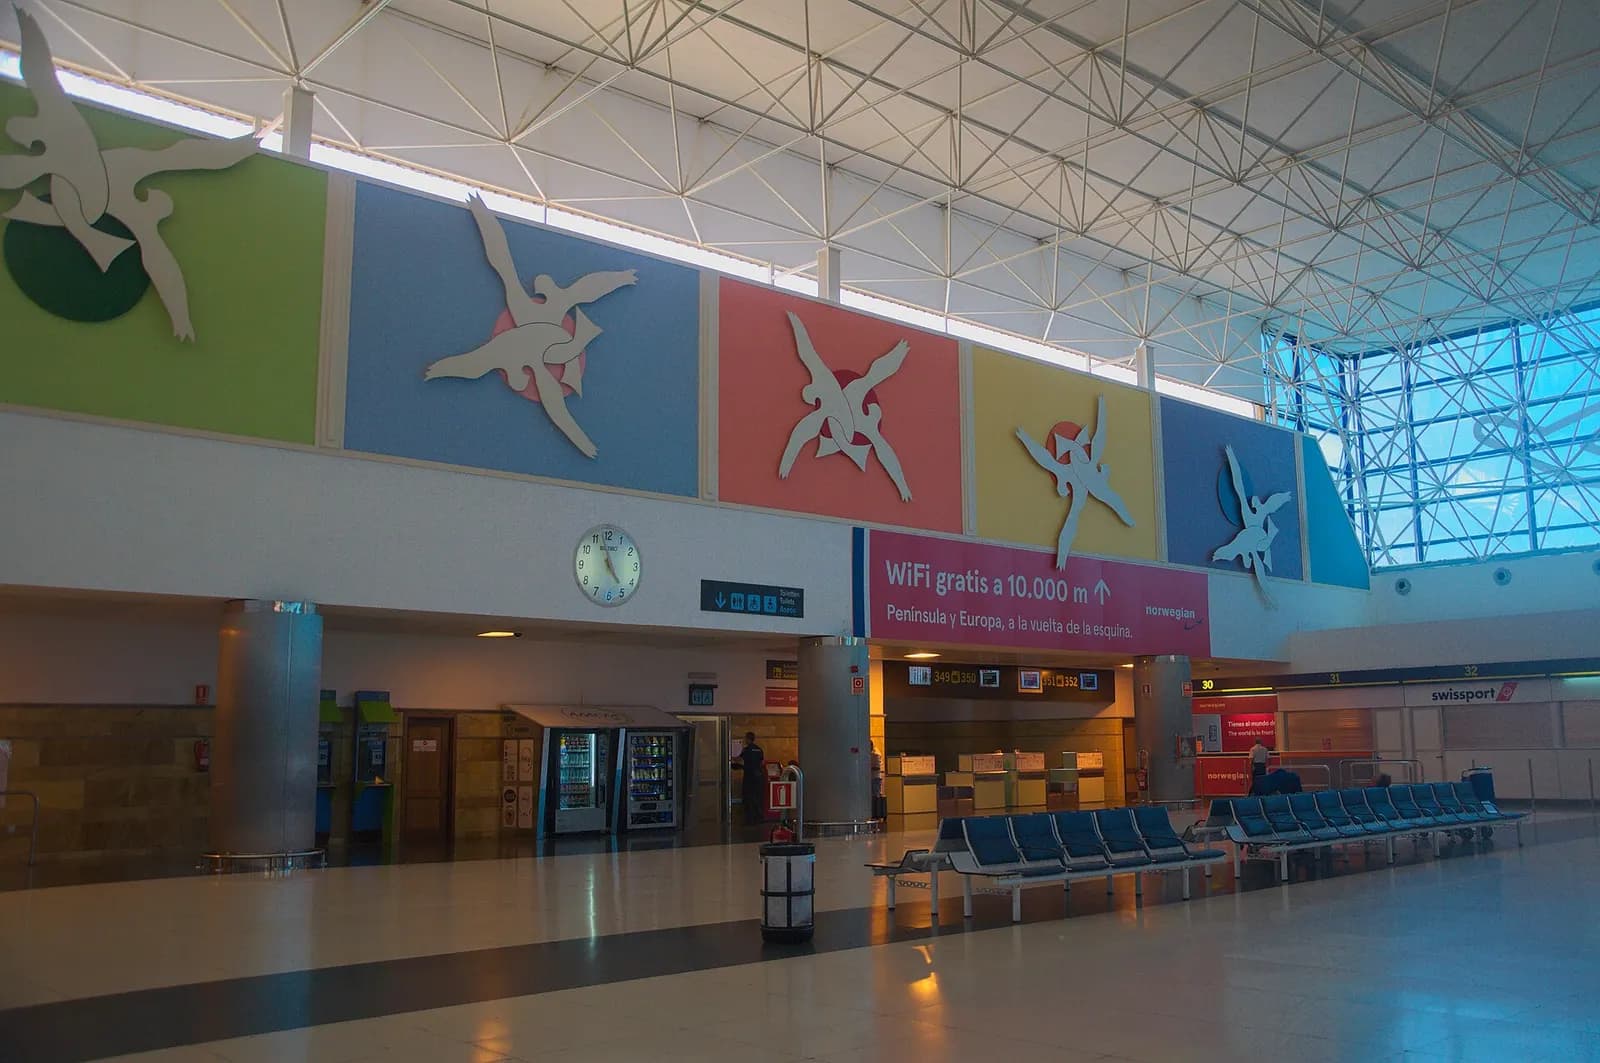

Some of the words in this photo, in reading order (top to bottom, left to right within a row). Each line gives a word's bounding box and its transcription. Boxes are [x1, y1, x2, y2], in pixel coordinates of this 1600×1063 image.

[592, 534, 599, 544] 11
[604, 531, 613, 540] 12
[619, 536, 623, 544] 1
[583, 545, 591, 554] 10
[627, 547, 634, 556] 2
[578, 560, 584, 570] 9
[633, 562, 638, 572] 3
[583, 576, 588, 585] 8
[629, 578, 634, 586] 4
[886, 560, 930, 588] WiFi
[936, 569, 988, 596] gratis
[993, 578, 1003, 596] a
[1008, 574, 1068, 602] 10.000
[1073, 586, 1088, 604] m
[594, 586, 599, 596] 7
[606, 592, 612, 600] 6
[619, 588, 624, 598] 5
[1146, 604, 1195, 620] norwegian
[887, 604, 947, 624] Península
[950, 612, 957, 629] y
[960, 610, 1005, 632] Europa,
[1008, 618, 1015, 630] a
[1018, 616, 1028, 631] la
[1030, 618, 1062, 632] vuelta
[1066, 620, 1080, 634] de
[1082, 622, 1091, 636] la
[1093, 624, 1133, 640] esquina.
[1464, 666, 1479, 676] 32
[934, 671, 950, 682] 349
[960, 672, 976, 684] 350
[1064, 676, 1078, 687] 352
[1330, 673, 1340, 684] 31
[1202, 680, 1214, 690] 30
[1432, 688, 1496, 702] swissport
